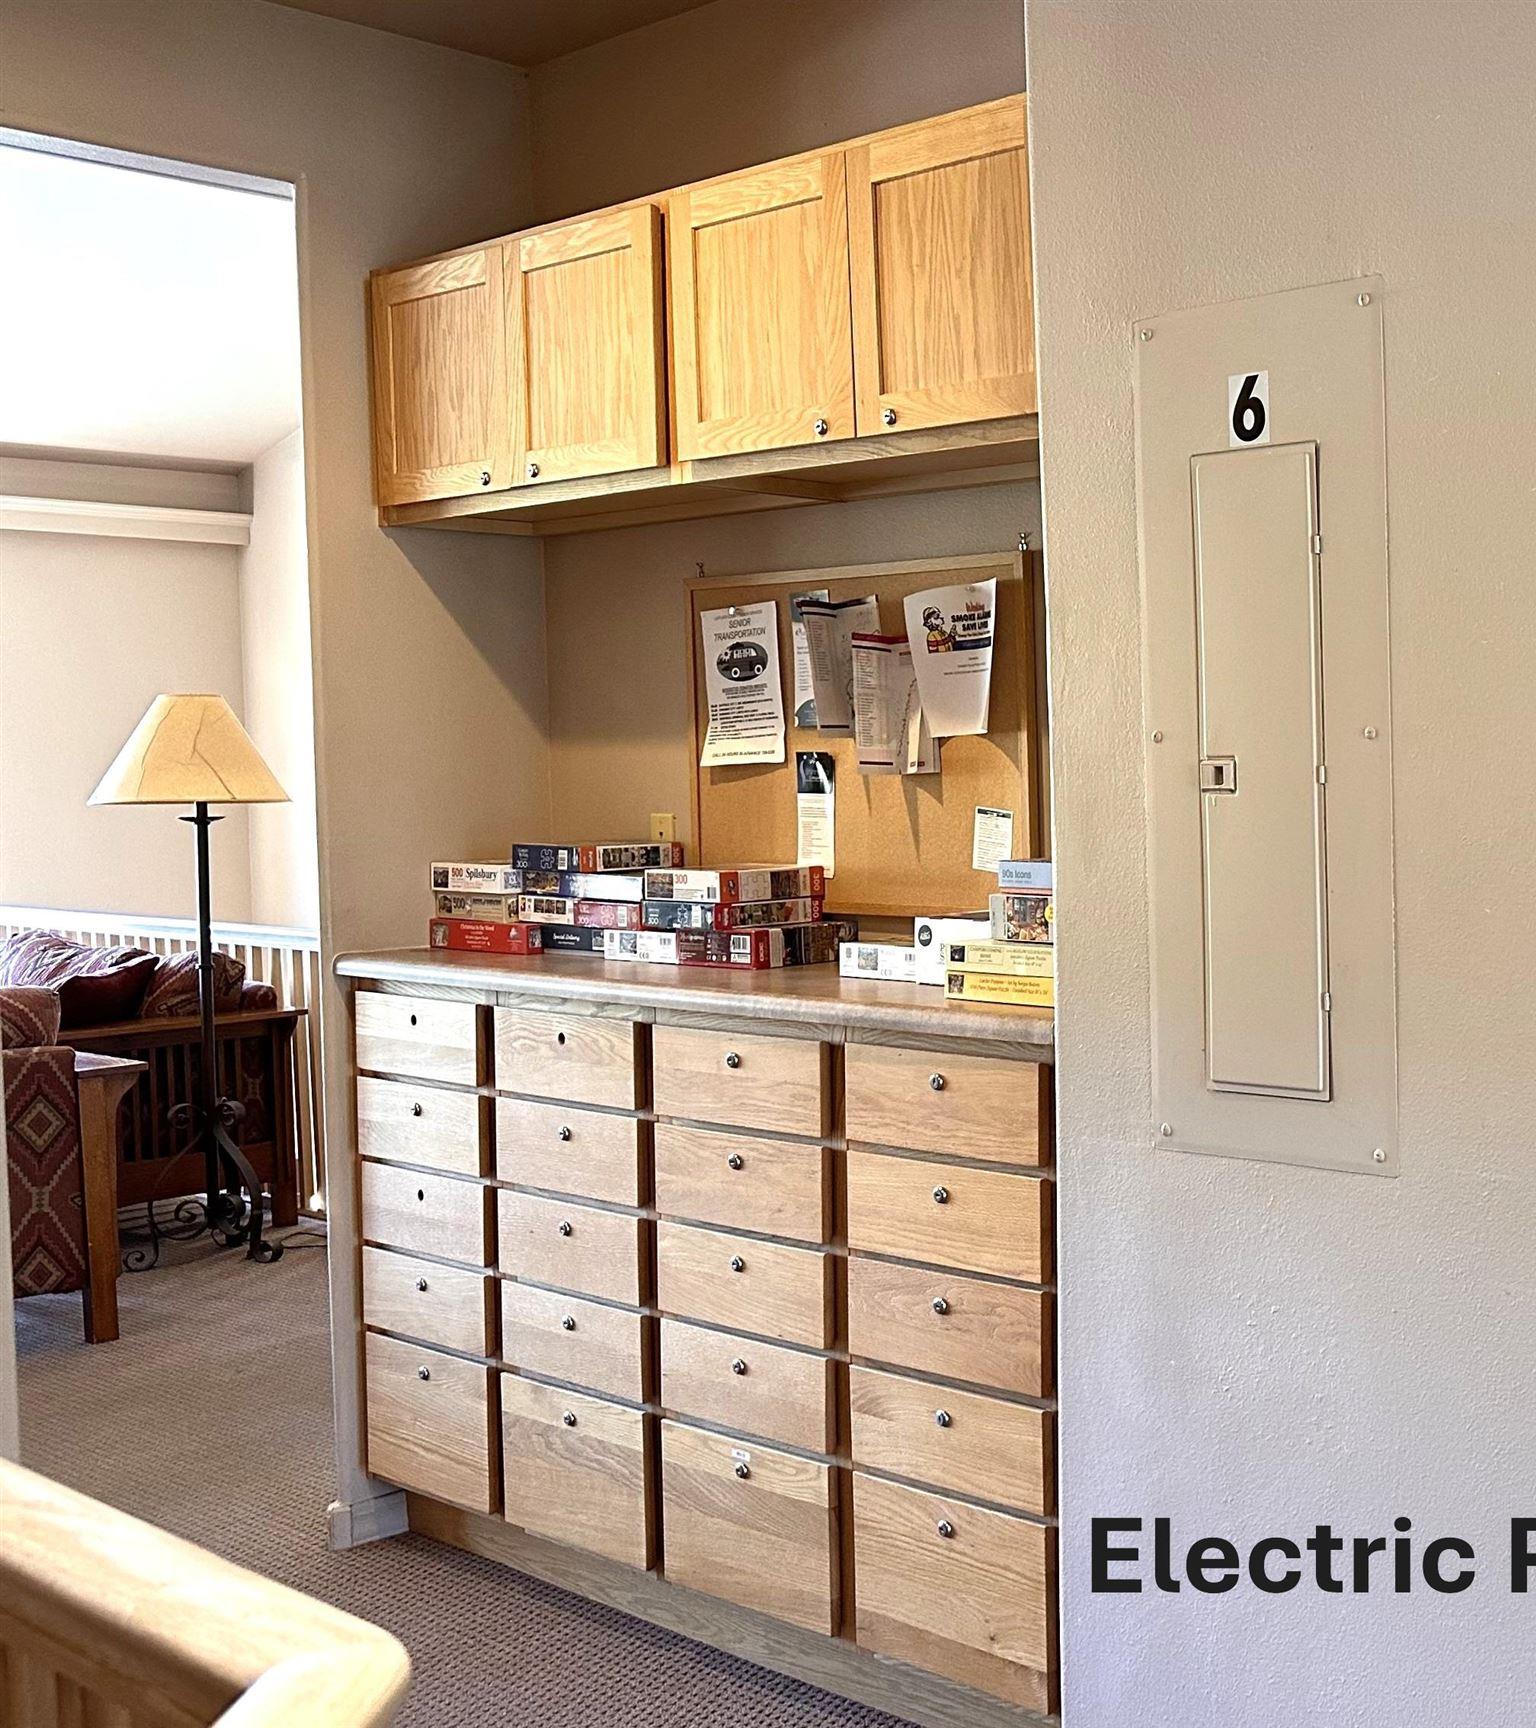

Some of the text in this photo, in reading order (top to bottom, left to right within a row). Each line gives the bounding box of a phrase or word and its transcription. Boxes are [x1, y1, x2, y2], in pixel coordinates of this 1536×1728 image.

[1232, 375, 1271, 448] 6
[728, 618, 751, 629] SENIOR
[951, 613, 976, 623] SMOKE
[714, 627, 767, 641] TRANSPORTATION
[452, 867, 497, 881] 500 Spilsbury
[674, 873, 688, 885] 300
[1014, 869, 1032, 879] Icons
[812, 873, 820, 891] 300
[453, 896, 465, 909] 500
